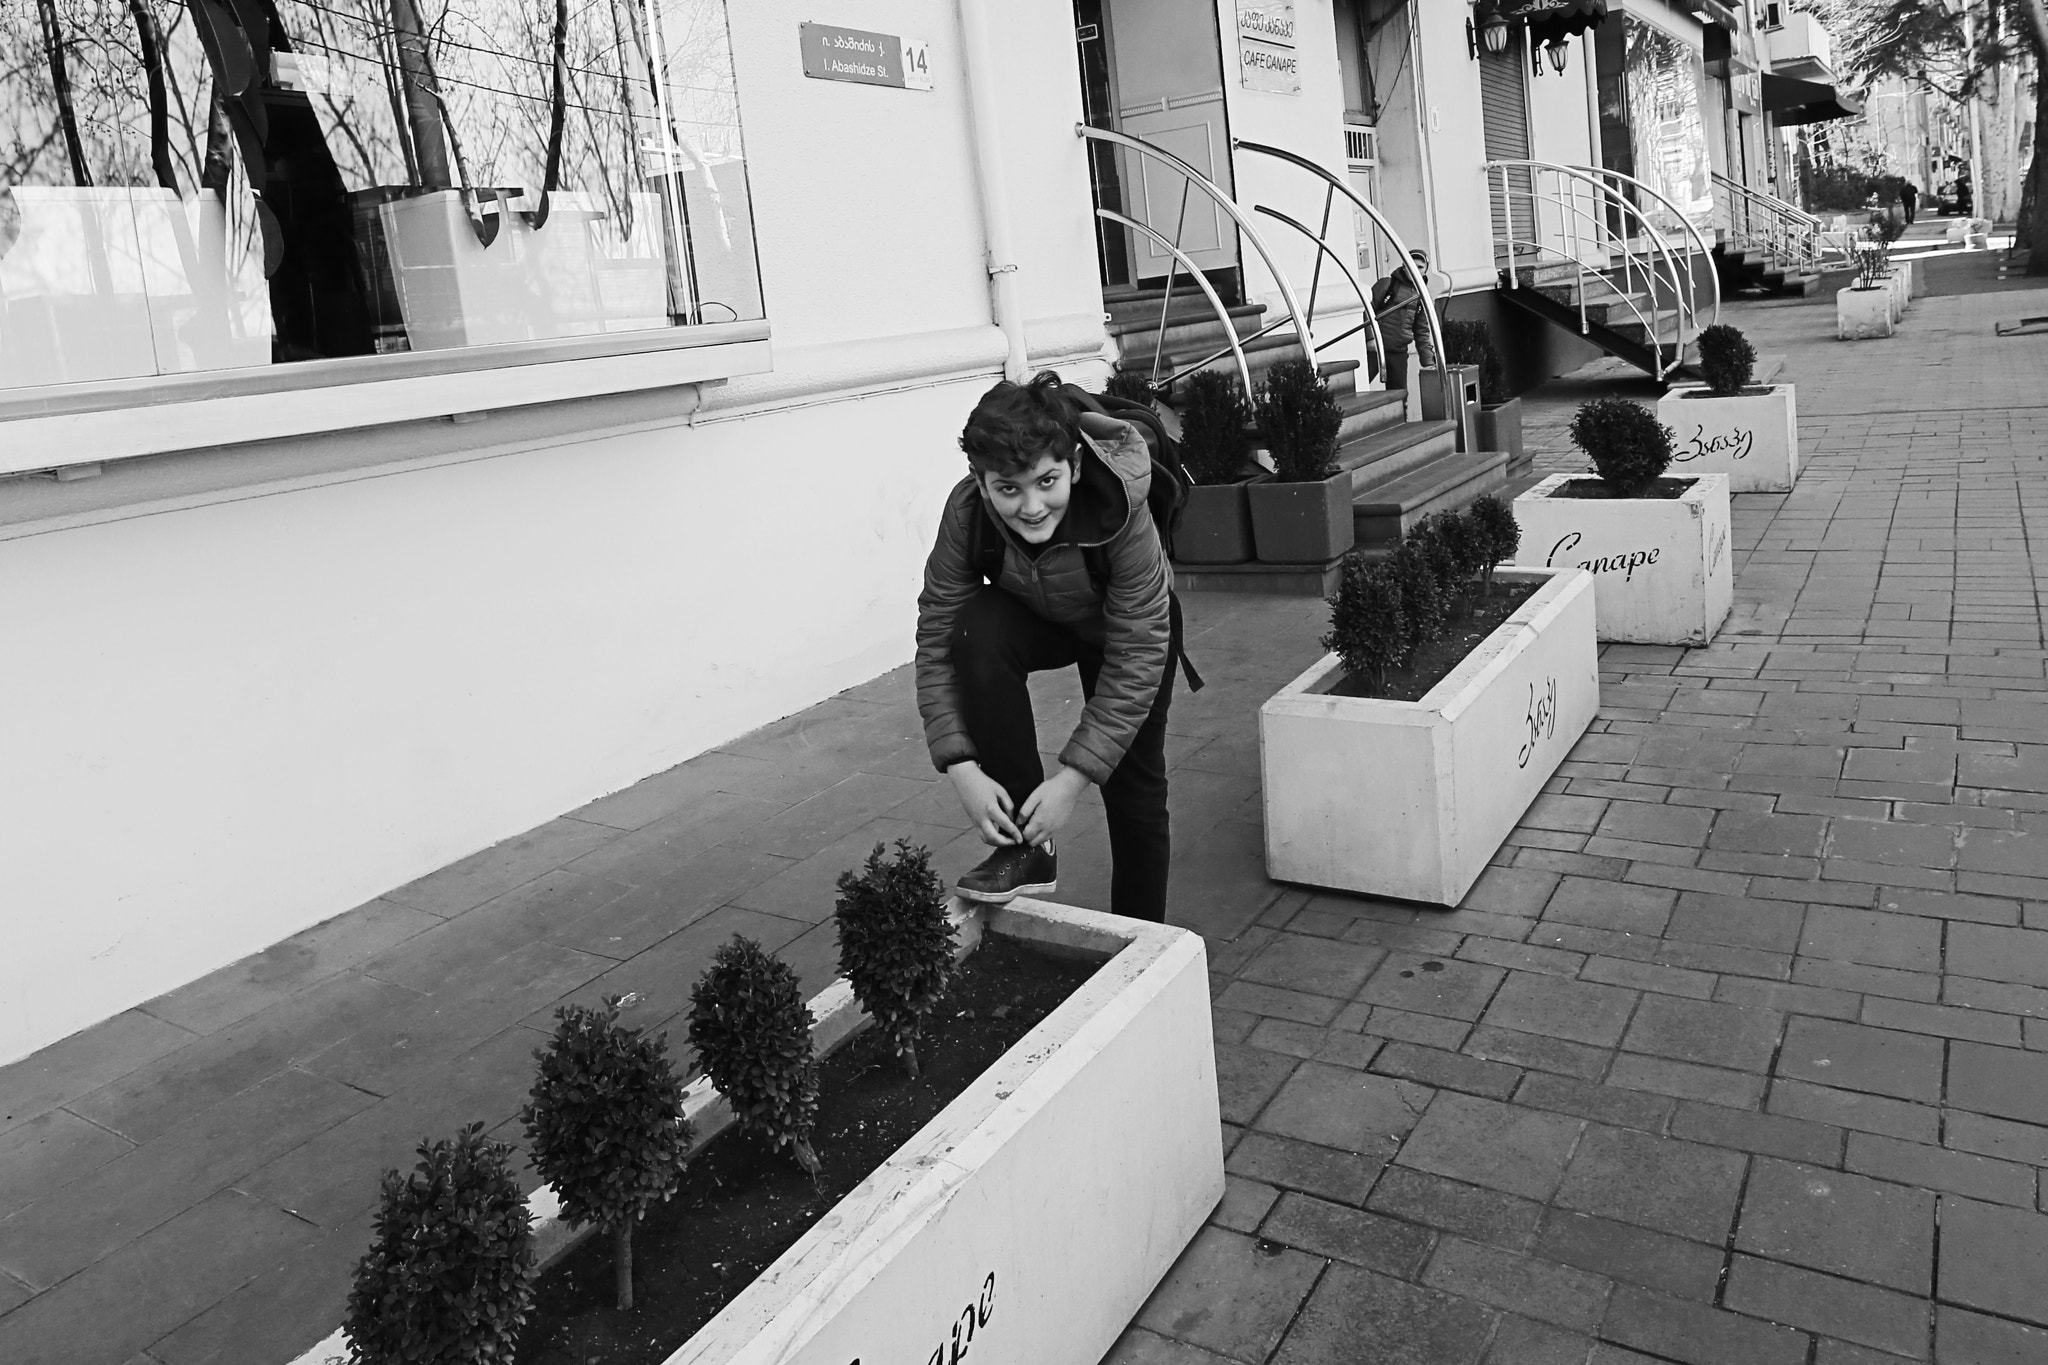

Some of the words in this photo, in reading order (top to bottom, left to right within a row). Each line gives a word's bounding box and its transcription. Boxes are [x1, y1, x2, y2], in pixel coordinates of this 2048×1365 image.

[831, 59, 876, 77] Abashidze
[877, 65, 889, 78] St.
[905, 47, 928, 74] 14
[1243, 50, 1266, 69] CAFE
[1265, 54, 1297, 74] CANAPE
